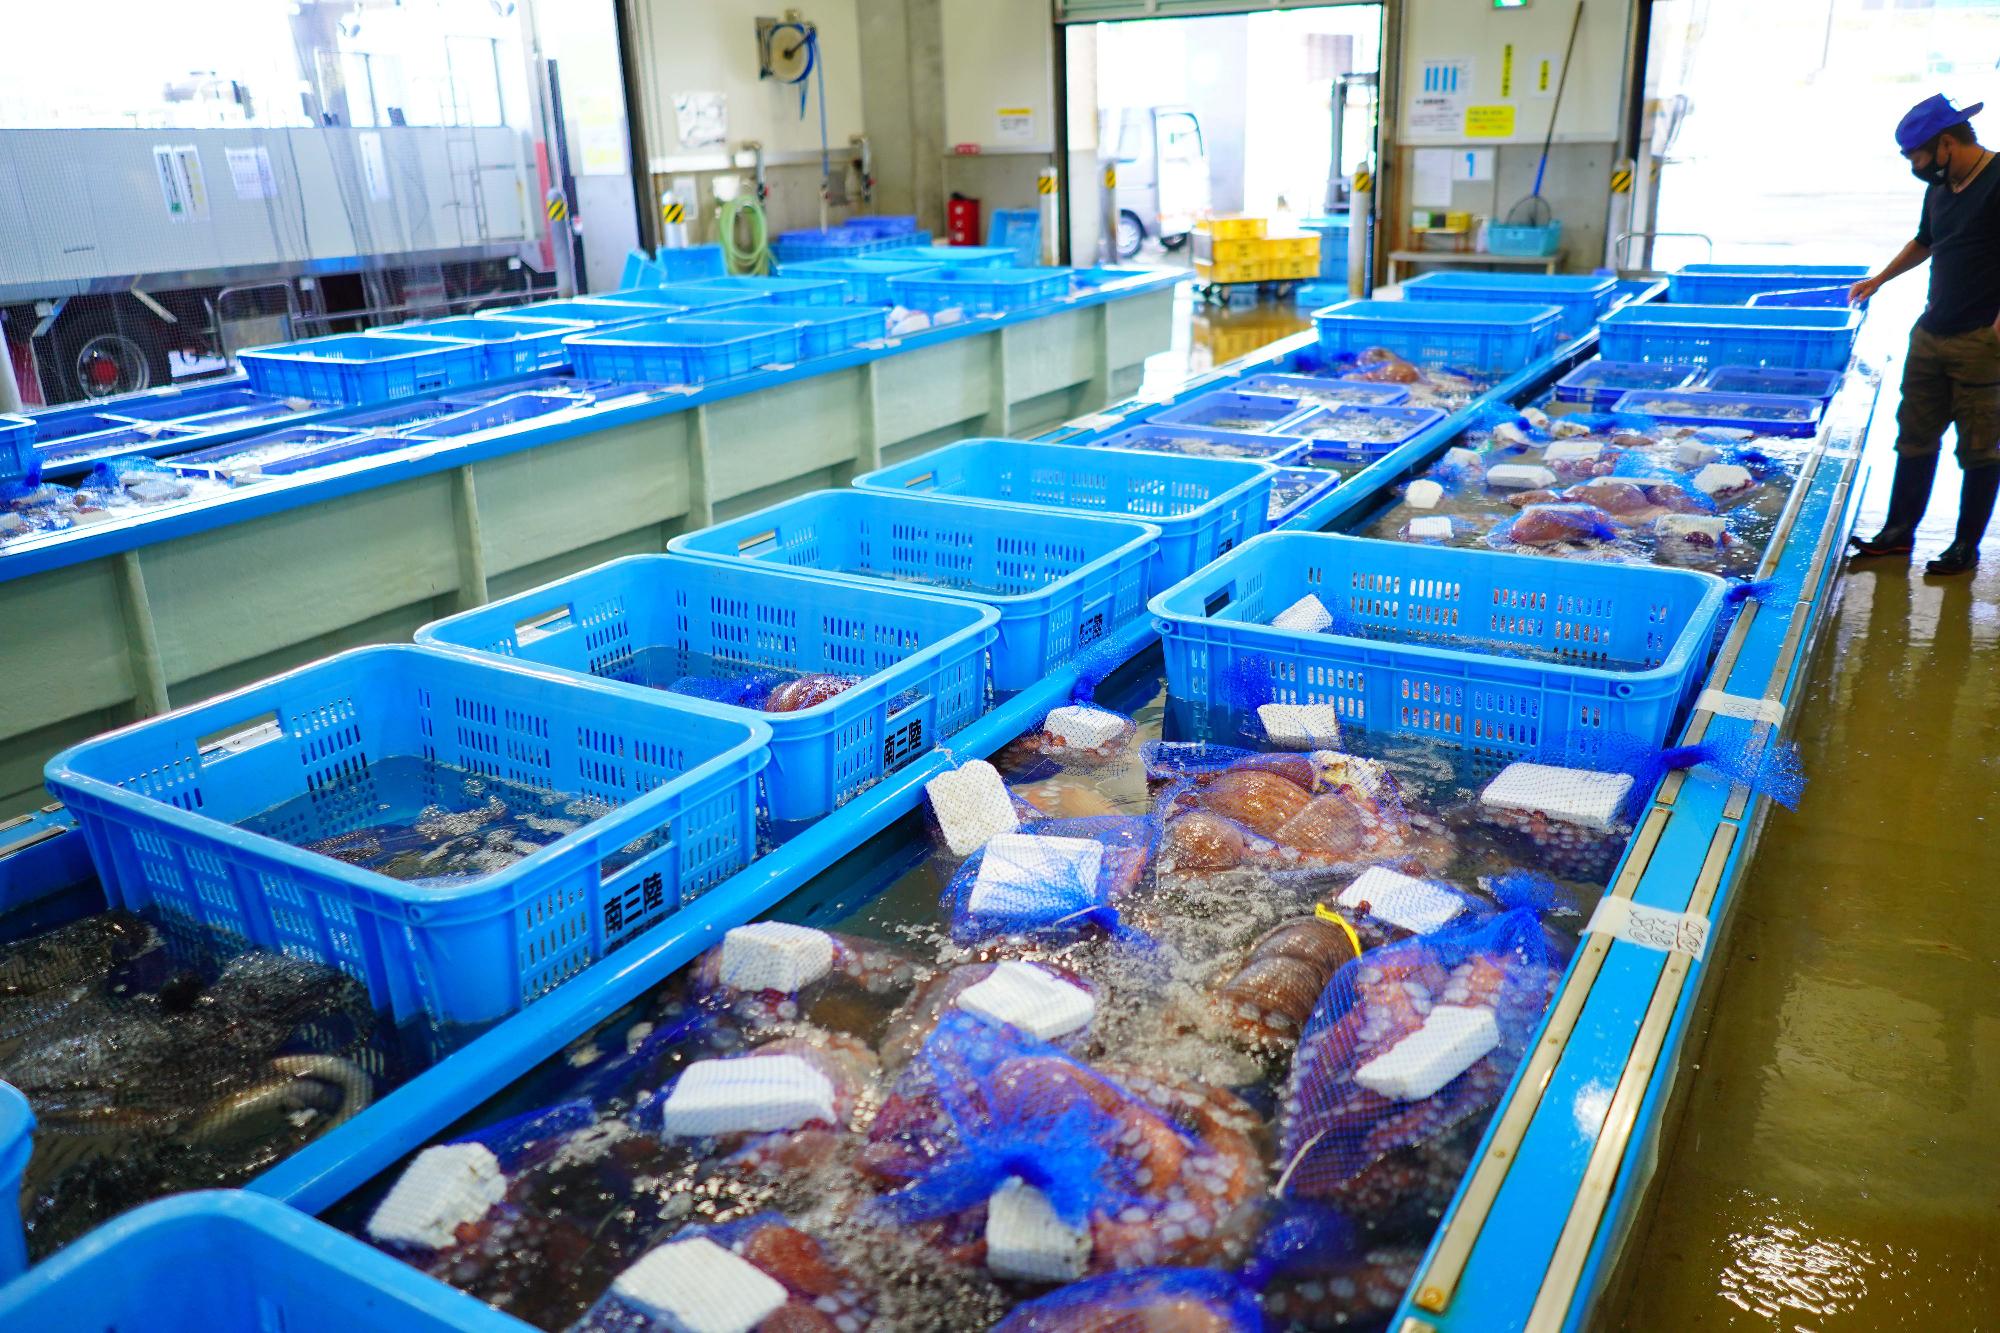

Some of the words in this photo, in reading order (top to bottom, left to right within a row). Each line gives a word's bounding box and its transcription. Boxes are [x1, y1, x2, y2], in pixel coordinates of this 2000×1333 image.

[1466, 152, 1474, 177] 1
[884, 718, 922, 769] 南三陸
[604, 872, 664, 939] 南三陸
